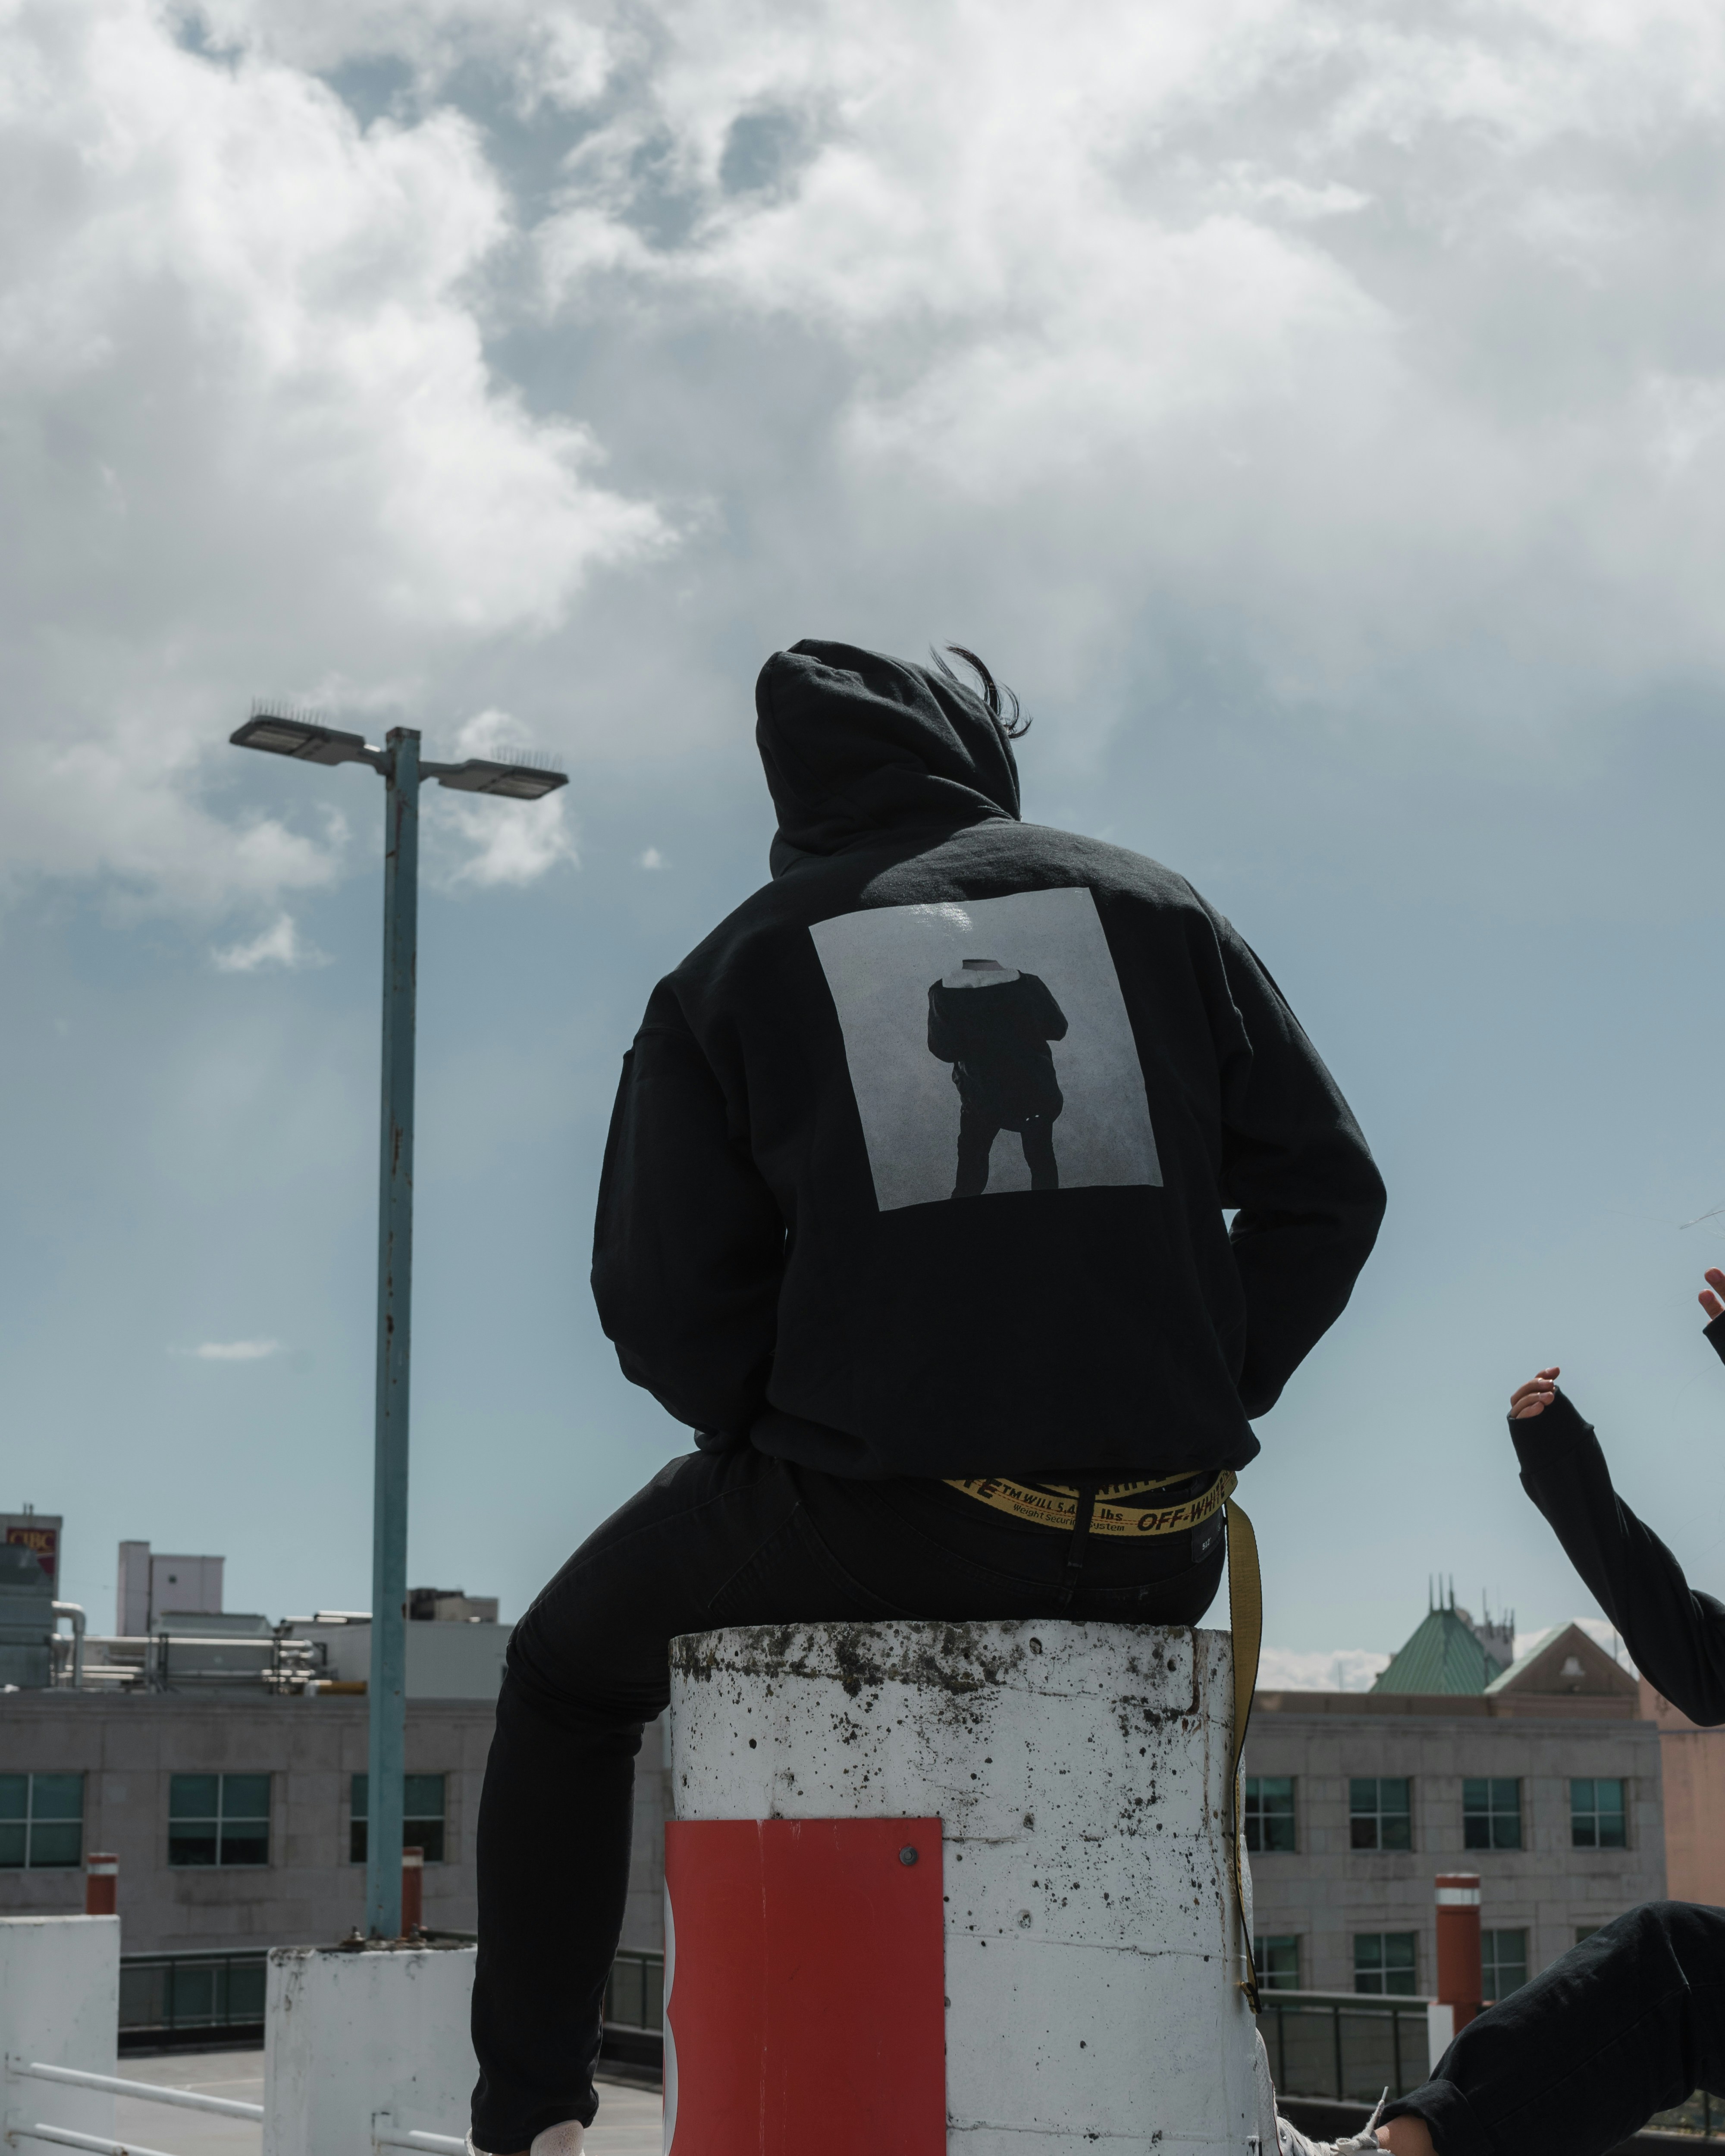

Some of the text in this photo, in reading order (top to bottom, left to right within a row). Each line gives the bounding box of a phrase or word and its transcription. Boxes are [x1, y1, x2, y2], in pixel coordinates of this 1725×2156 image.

[1014, 1504, 1044, 1519] Weight
[1045, 1514, 1076, 1525] Securin
[1024, 1494, 1052, 1510] WILL
[1101, 1508, 1123, 1521] lbs
